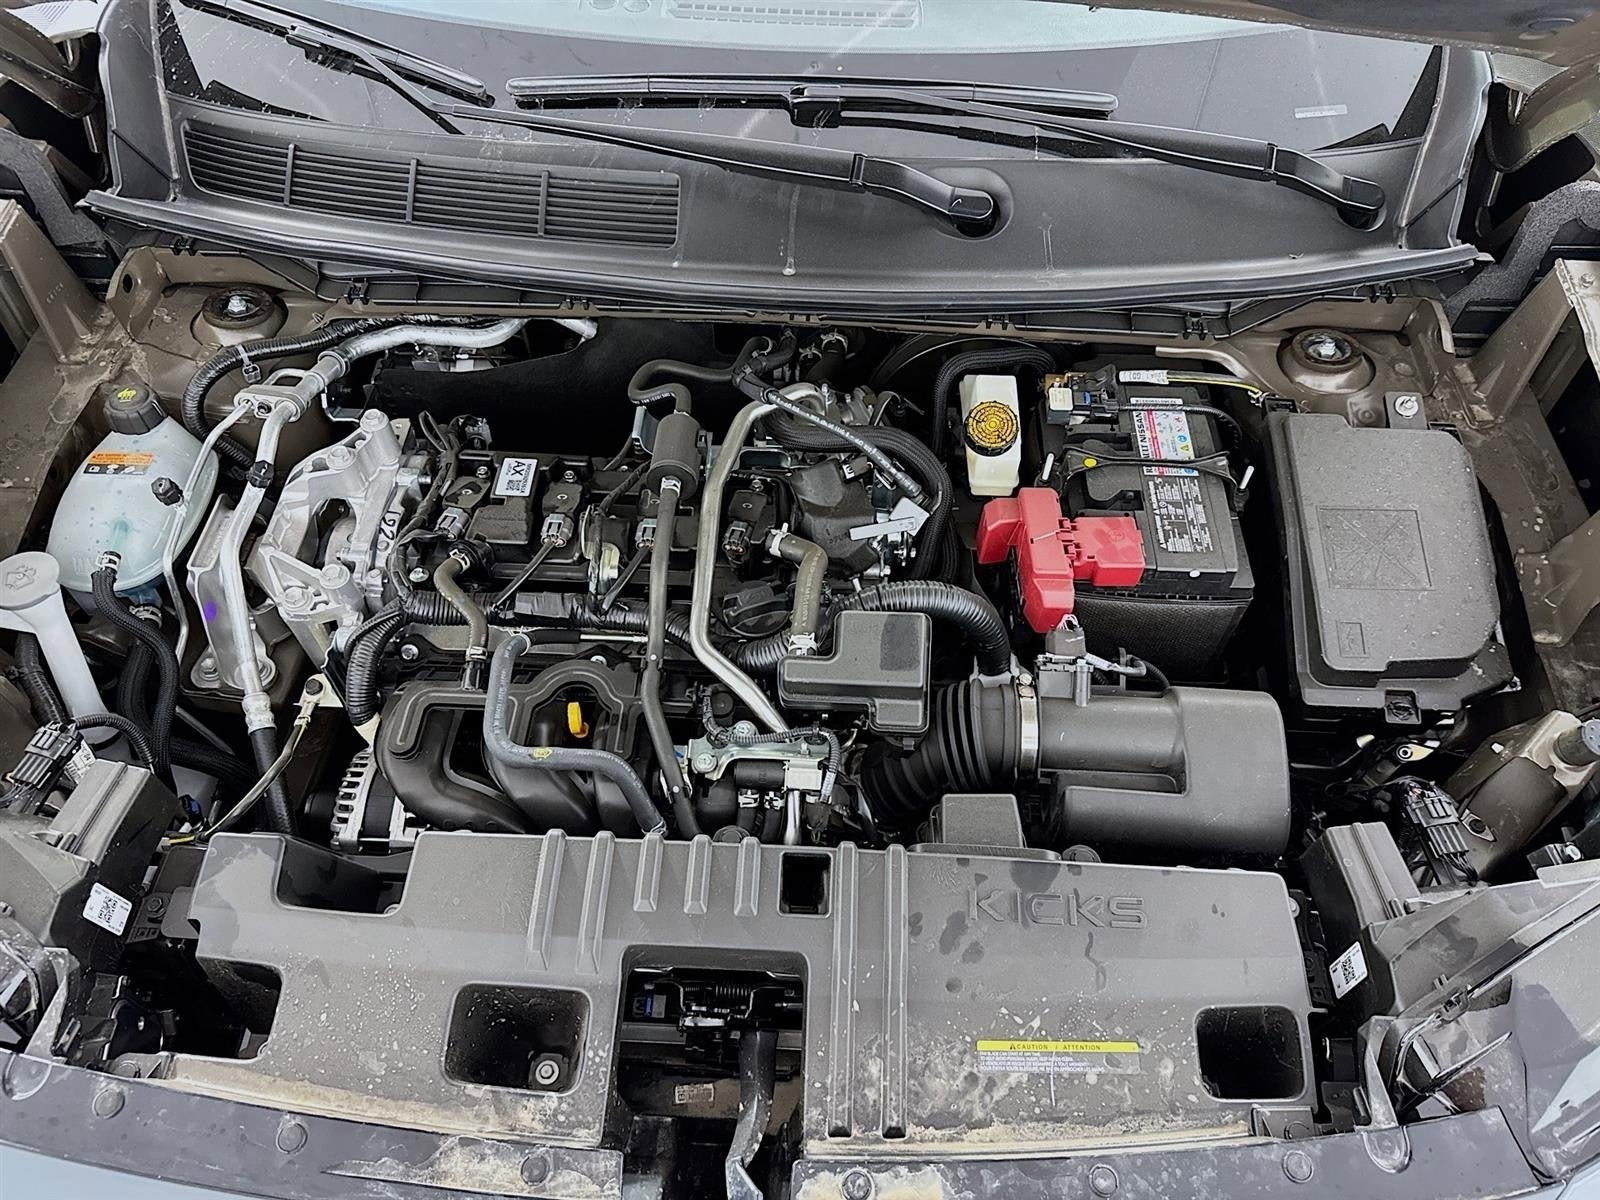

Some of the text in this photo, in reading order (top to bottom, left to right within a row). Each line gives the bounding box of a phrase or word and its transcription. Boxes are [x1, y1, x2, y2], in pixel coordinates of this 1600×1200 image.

[1135, 411, 1147, 443] NISSAN
[511, 460, 526, 476] AX
[968, 888, 1147, 929] KICKS
[1017, 1042, 1048, 1050] CAUTION
[1062, 1042, 1101, 1051] ATTENTION
